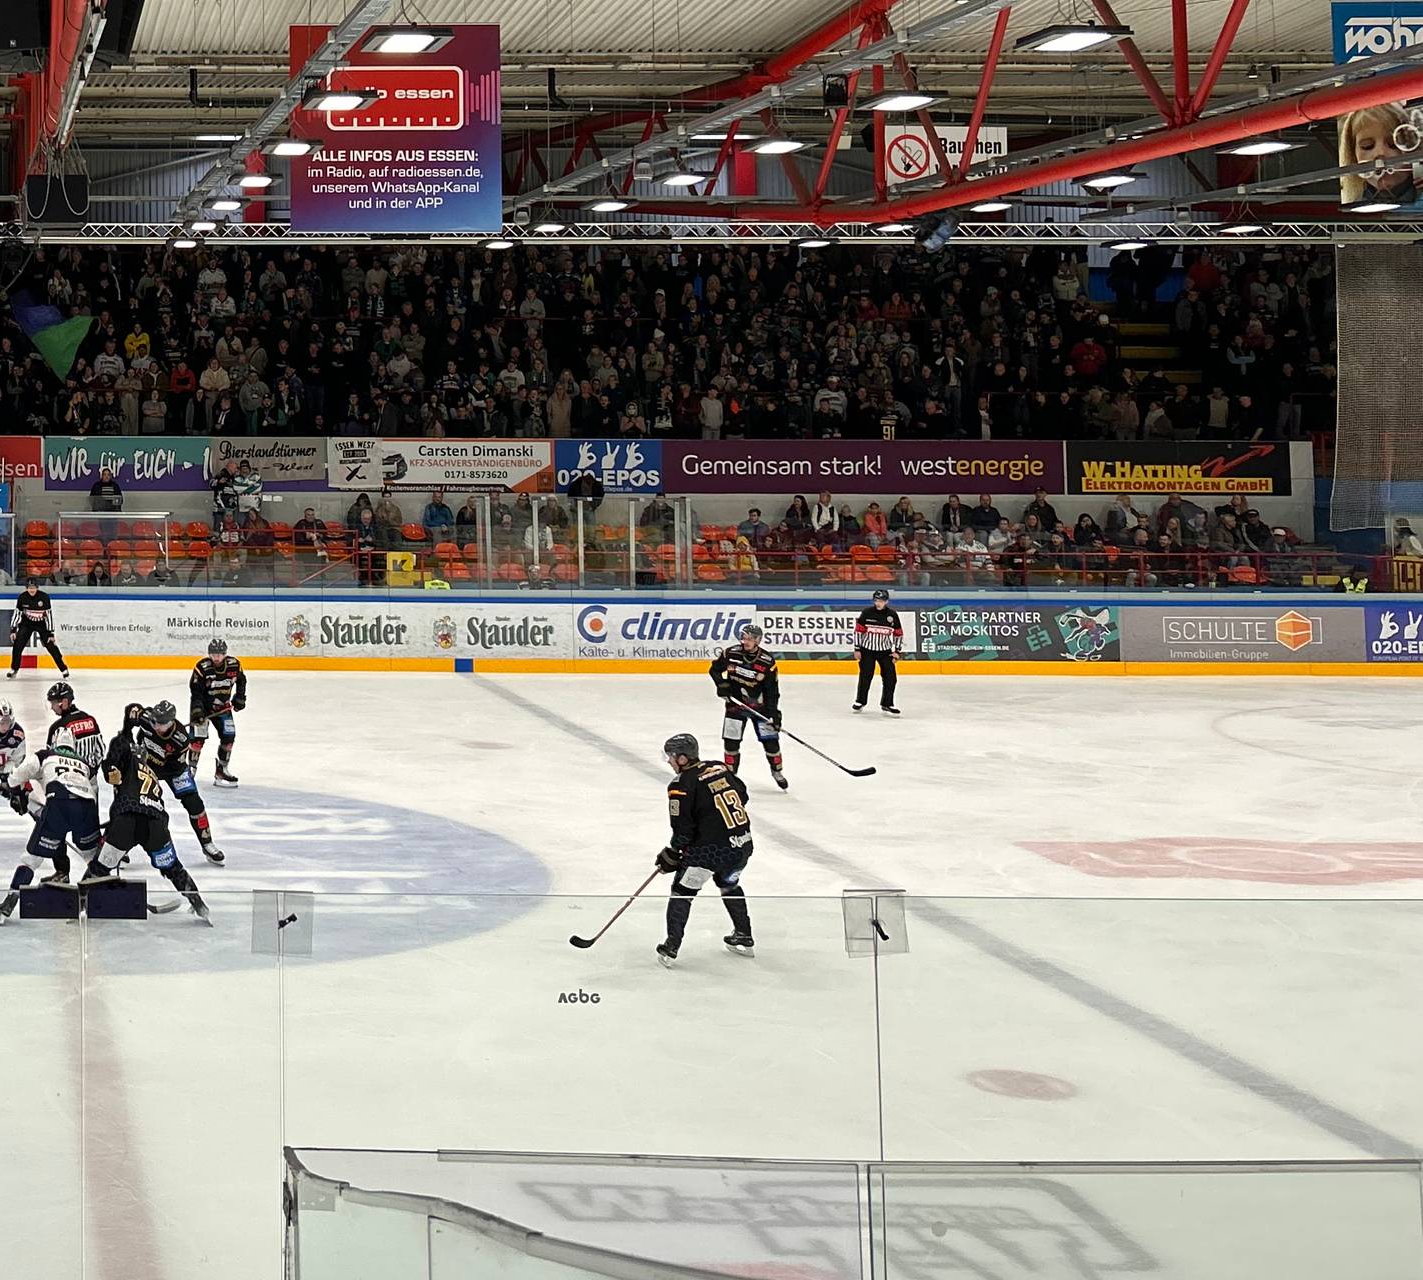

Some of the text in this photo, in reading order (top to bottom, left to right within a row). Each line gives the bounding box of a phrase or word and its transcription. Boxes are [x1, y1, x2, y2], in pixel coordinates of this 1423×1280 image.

[395, 89, 454, 99] essen
[312, 150, 479, 162] ALLE INFOS AUS ESSEN:
[308, 166, 484, 179] im Radio, auf radioessen.de,
[312, 182, 479, 195] unserem WhatsApp-Kanal
[349, 198, 444, 209] und in der APP
[219, 440, 316, 461] Bierstandstürmer
[357, 441, 375, 449] WEST
[418, 445, 534, 457] Carsten Dimanski
[49, 447, 92, 481] WIR
[134, 447, 175, 481] EUCH
[681, 454, 1044, 480] Gemeinsam stark! westenergie
[1082, 461, 1203, 478] W. HATTING
[444, 470, 508, 479] 0171-8573620
[167, 617, 270, 628] Märkische Revision
[764, 617, 856, 629] DER ESSENE
[919, 611, 1041, 623] STOLZER PARTNER
[60, 624, 73, 632] Wir
[106, 623, 126, 632] Ihren
[129, 623, 153, 633] Erfolg.
[321, 615, 407, 648] Stauder
[467, 616, 554, 649] Stauder
[921, 625, 1019, 637] DER MOSKITOS
[1168, 622, 1268, 641] SCHULTE
[764, 632, 855, 645] STADTGUTS
[579, 646, 614, 658] Kälte-
[633, 646, 711, 658] Klimatechnik
[1170, 649, 1269, 660] Immobilien-Gruppe
[713, 789, 748, 829] 13
